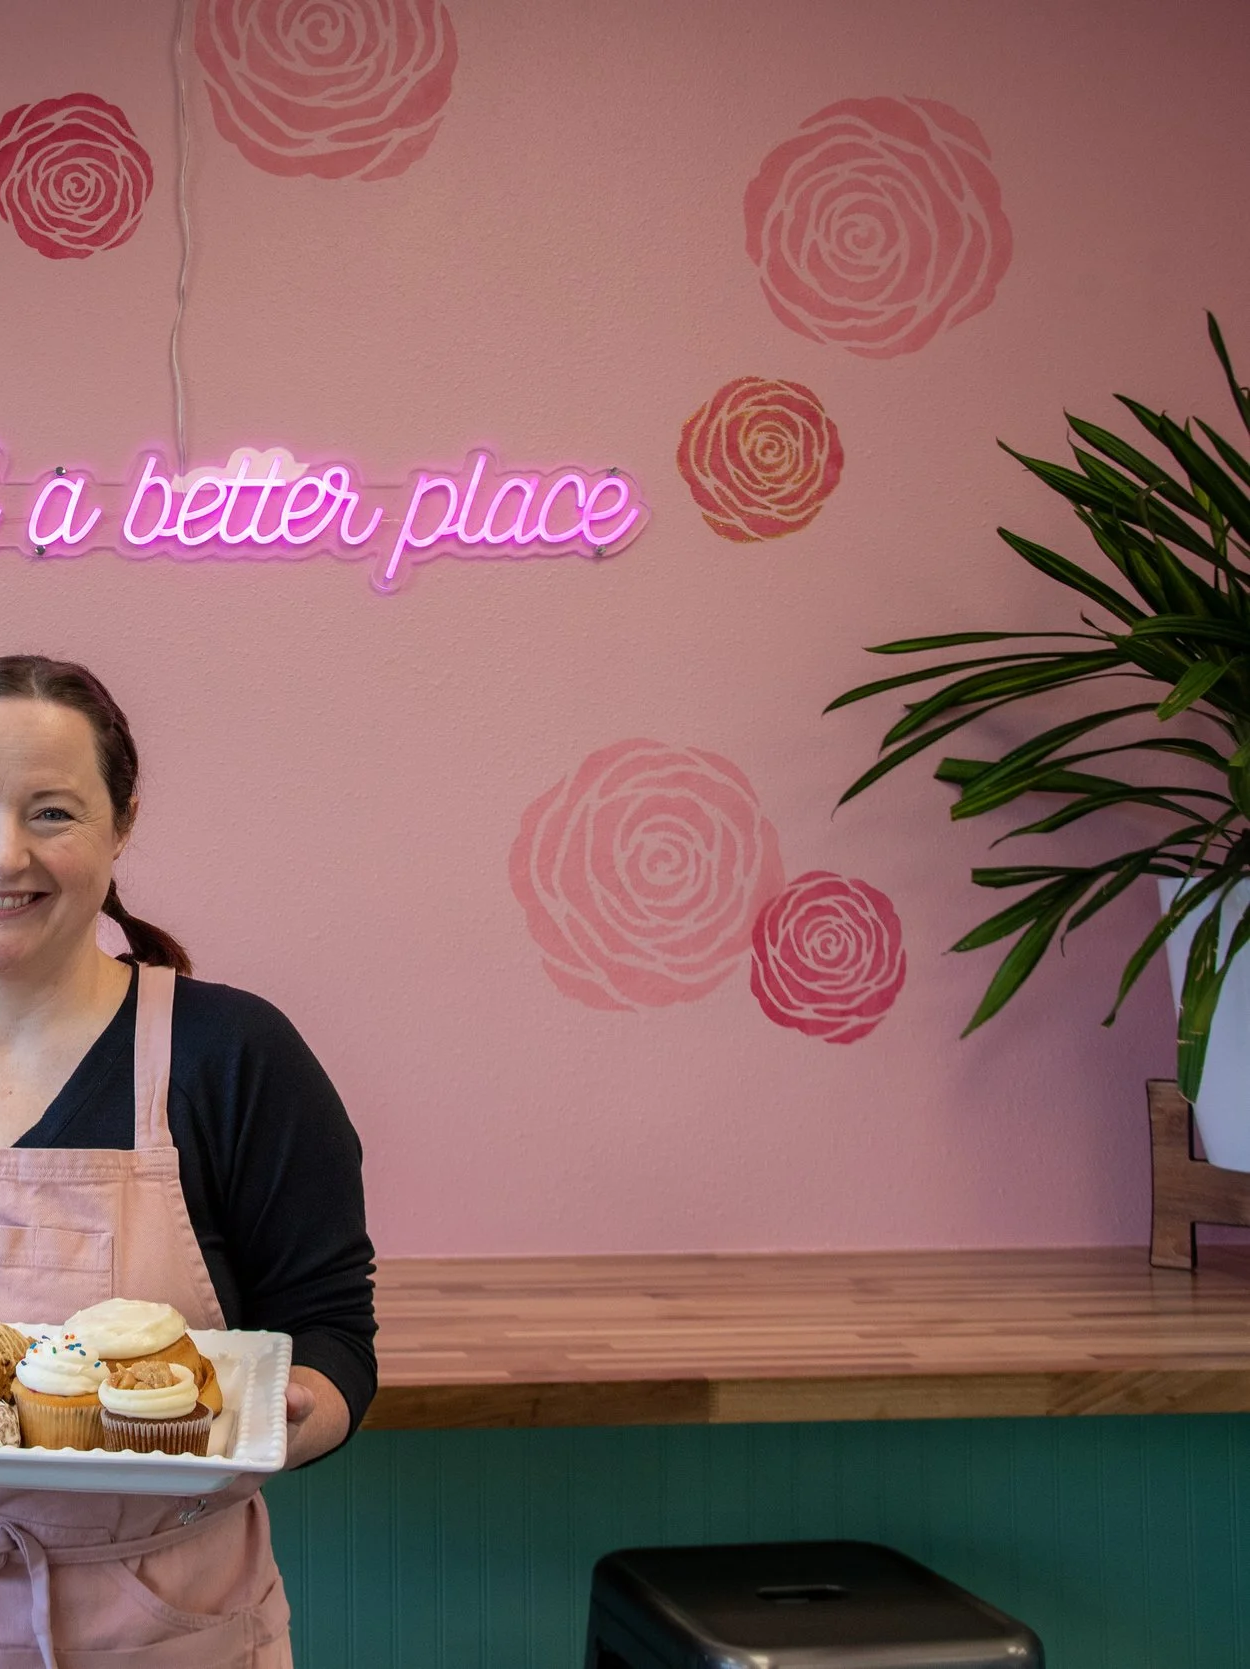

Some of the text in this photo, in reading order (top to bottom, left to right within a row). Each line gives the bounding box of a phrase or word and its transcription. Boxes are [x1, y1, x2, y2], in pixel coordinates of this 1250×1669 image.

[28, 477, 102, 545] a
[123, 456, 383, 545] better
[386, 455, 638, 579] place
